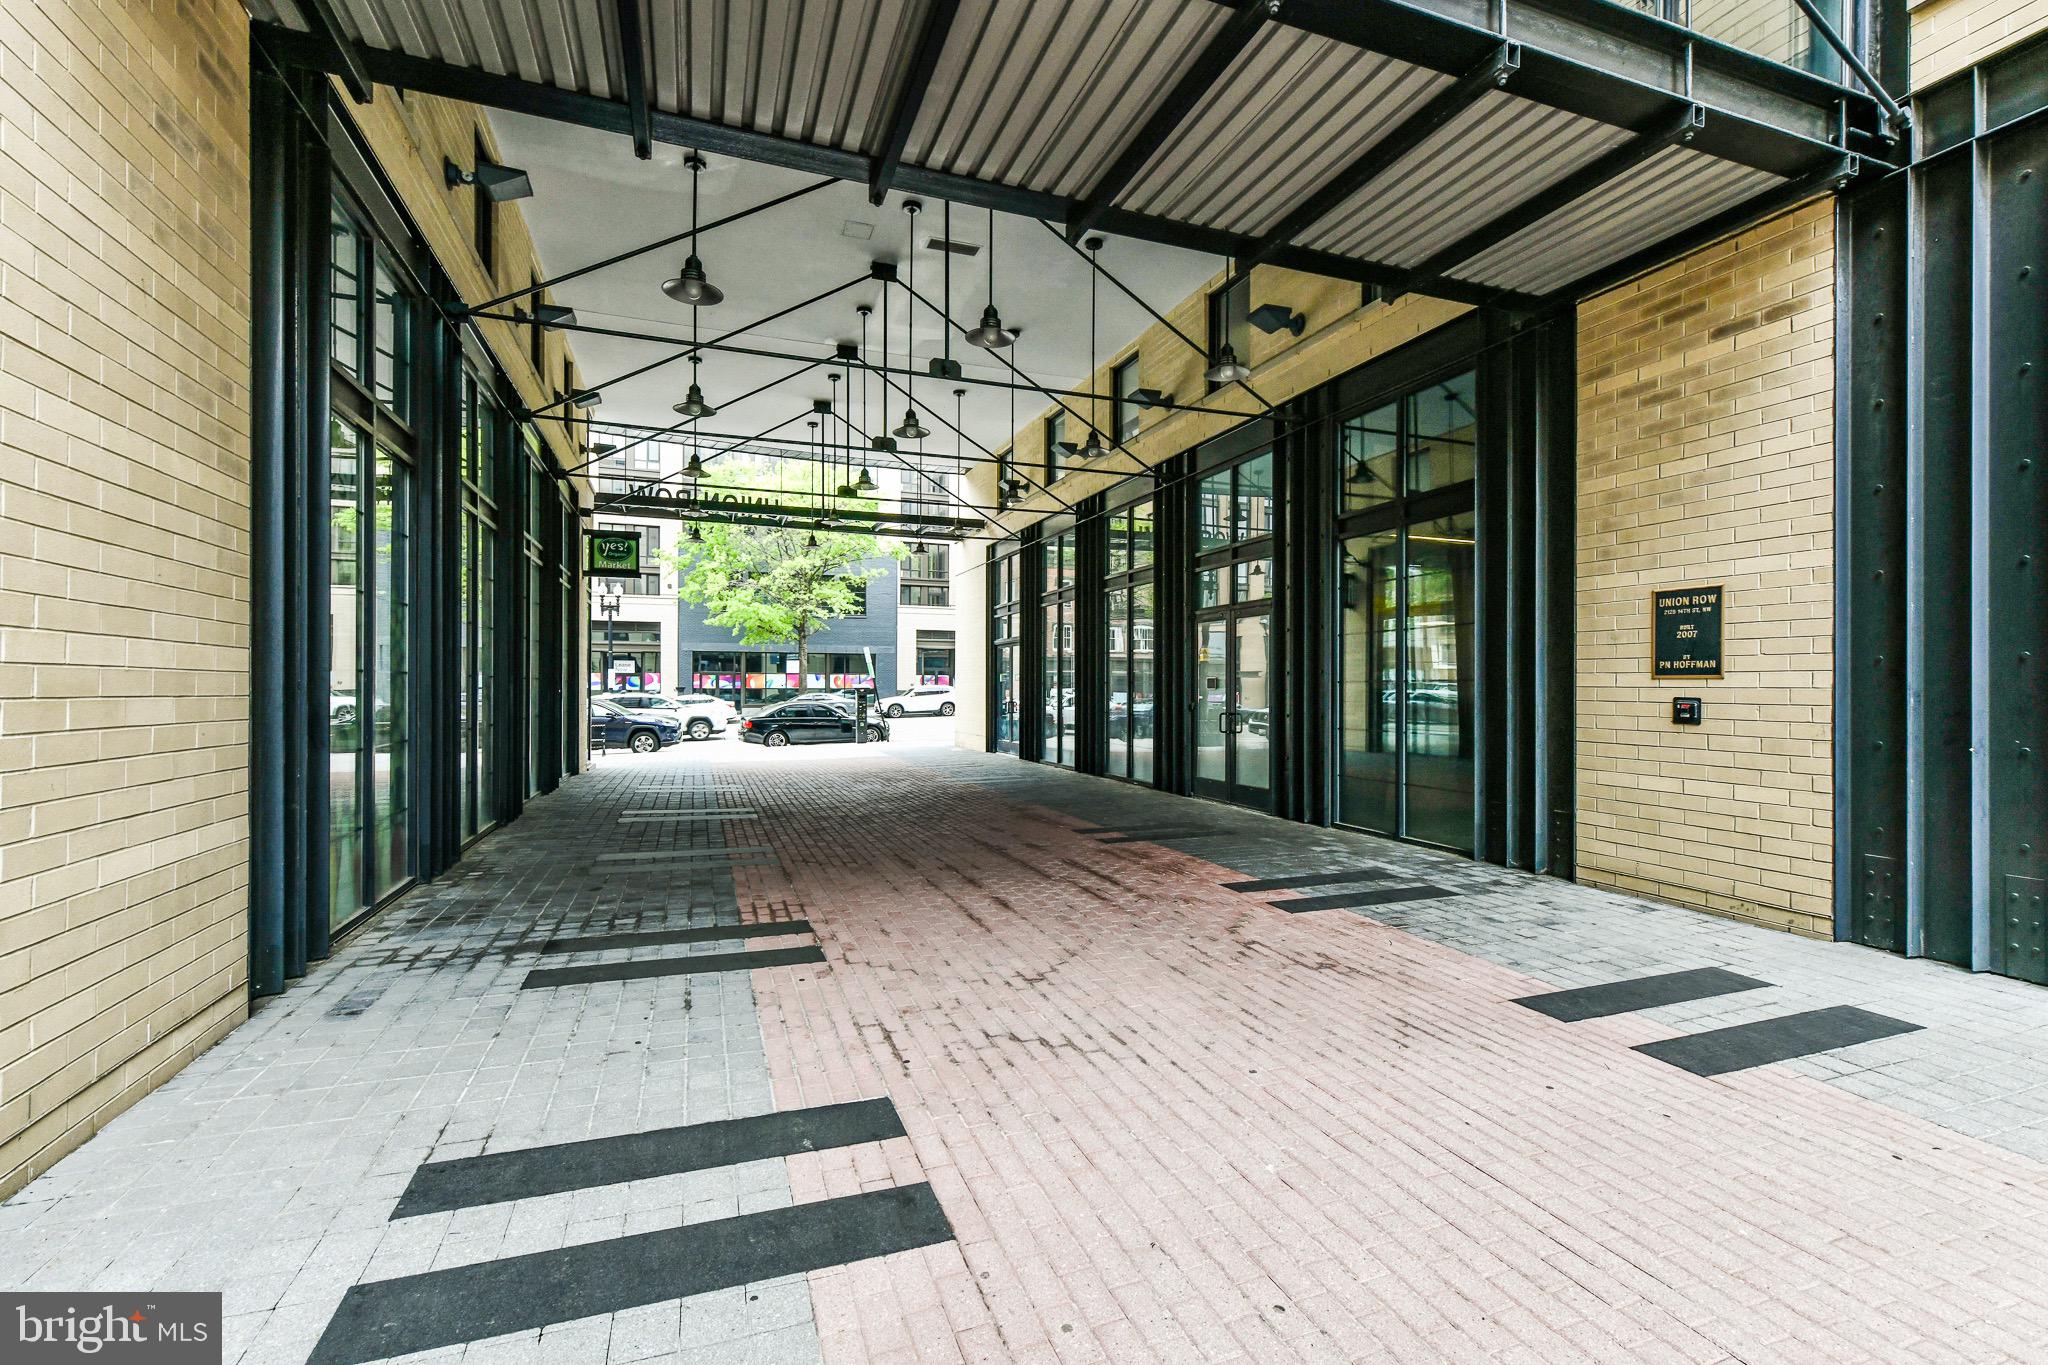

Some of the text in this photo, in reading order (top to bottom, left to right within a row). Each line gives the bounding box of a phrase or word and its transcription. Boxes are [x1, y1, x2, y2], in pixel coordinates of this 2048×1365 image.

[602, 542, 628, 556] yes!
[598, 560, 631, 569] Market
[1659, 594, 1717, 607] UNION ROW
[1676, 630, 1698, 638] 2007
[1660, 660, 1716, 669] PN HOFFMAN
